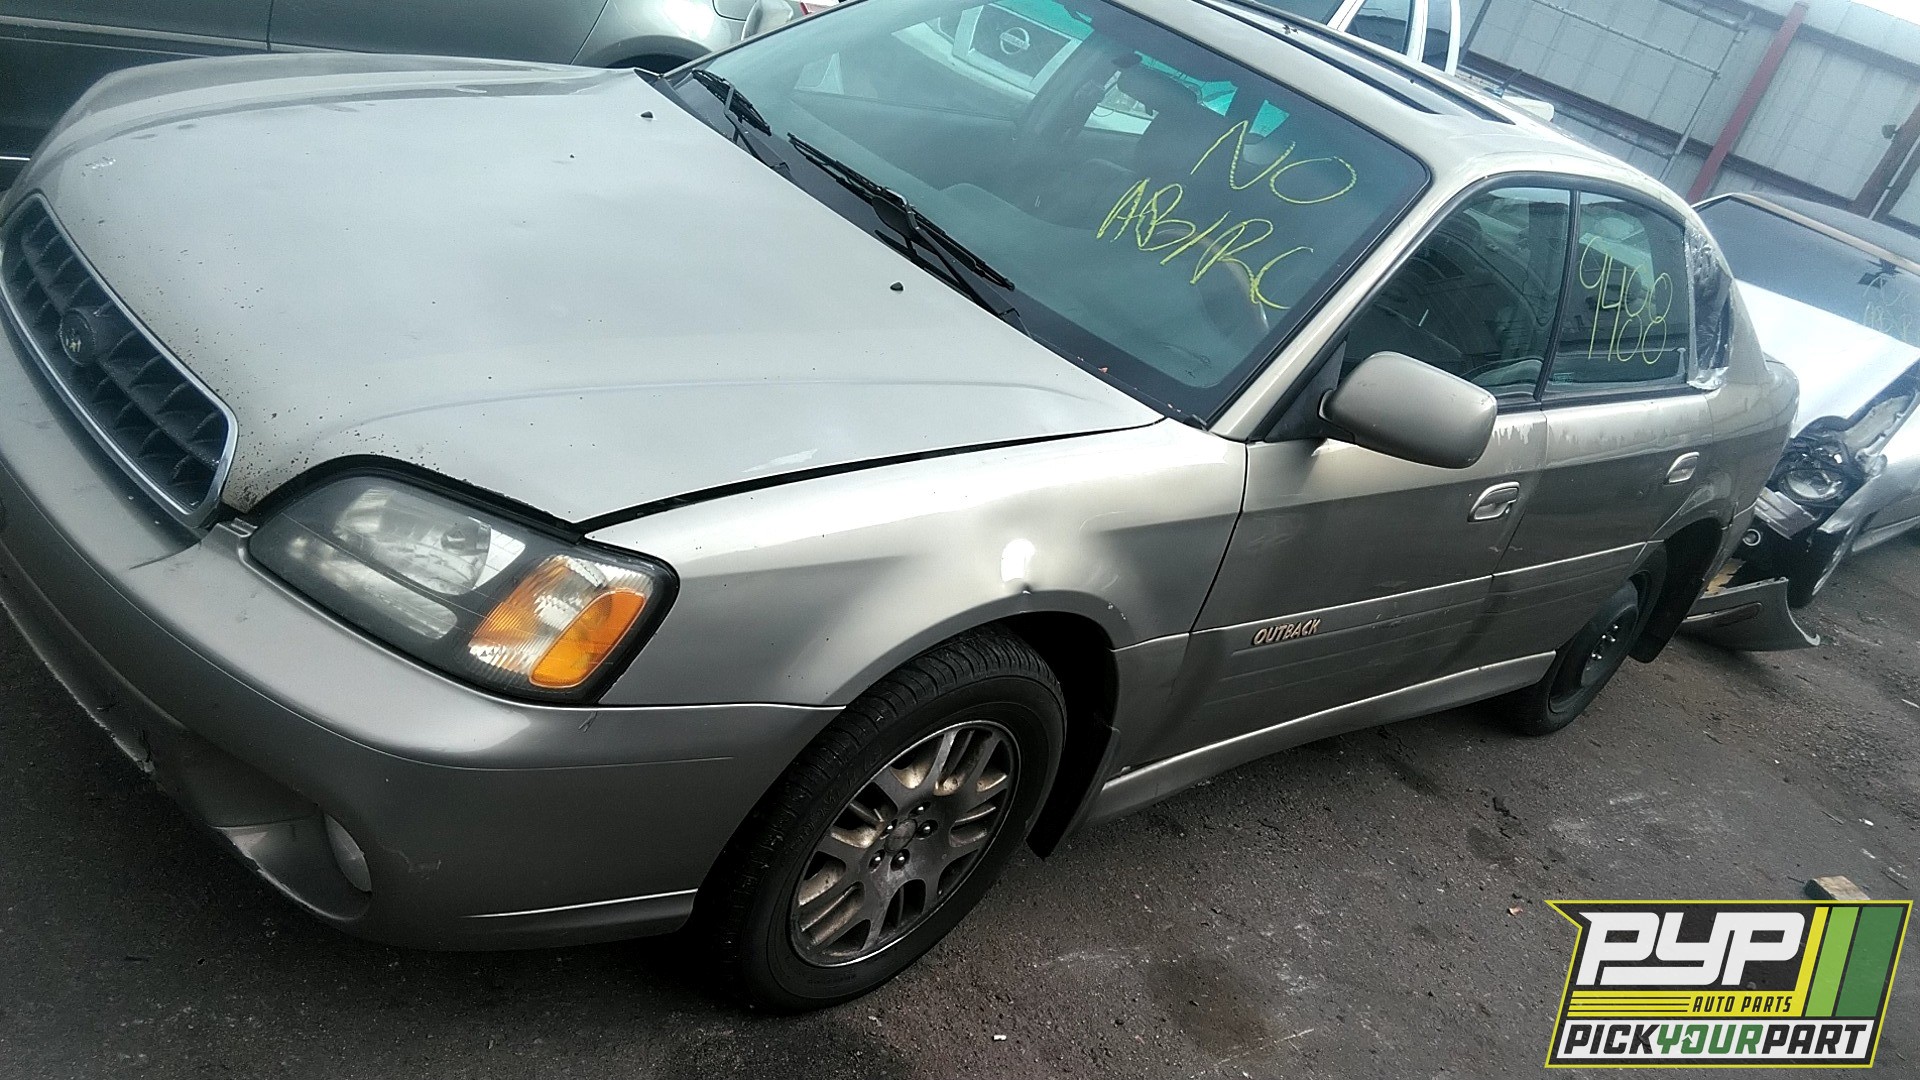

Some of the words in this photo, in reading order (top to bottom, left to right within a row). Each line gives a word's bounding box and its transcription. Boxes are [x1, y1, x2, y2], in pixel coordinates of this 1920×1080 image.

[1190, 120, 1357, 204] NO
[1579, 236, 1674, 365] 9488
[1251, 617, 1321, 646] OUTBACK
